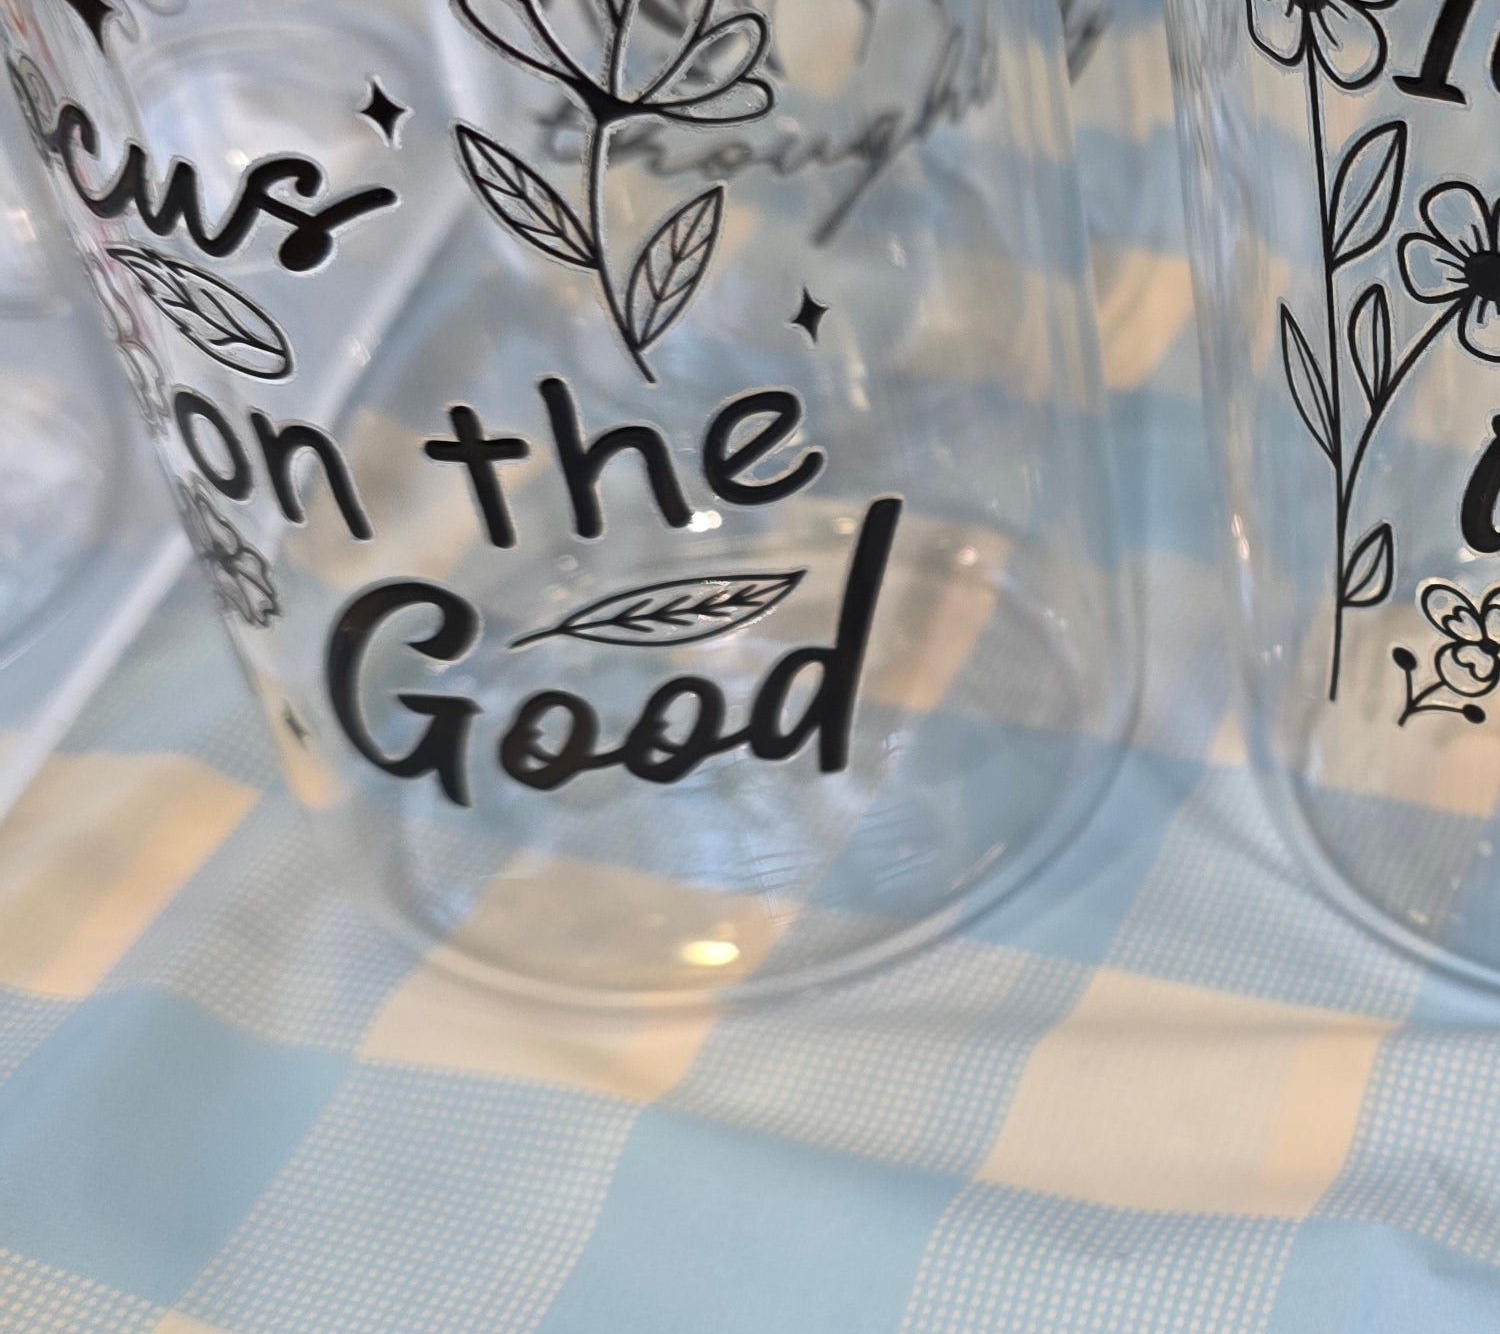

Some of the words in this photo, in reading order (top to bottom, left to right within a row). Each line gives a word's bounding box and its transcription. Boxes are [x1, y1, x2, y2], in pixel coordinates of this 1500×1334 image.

[50, 102, 398, 272] cus
[174, 384, 373, 541] on
[423, 375, 825, 549] the
[325, 495, 903, 810] Good
